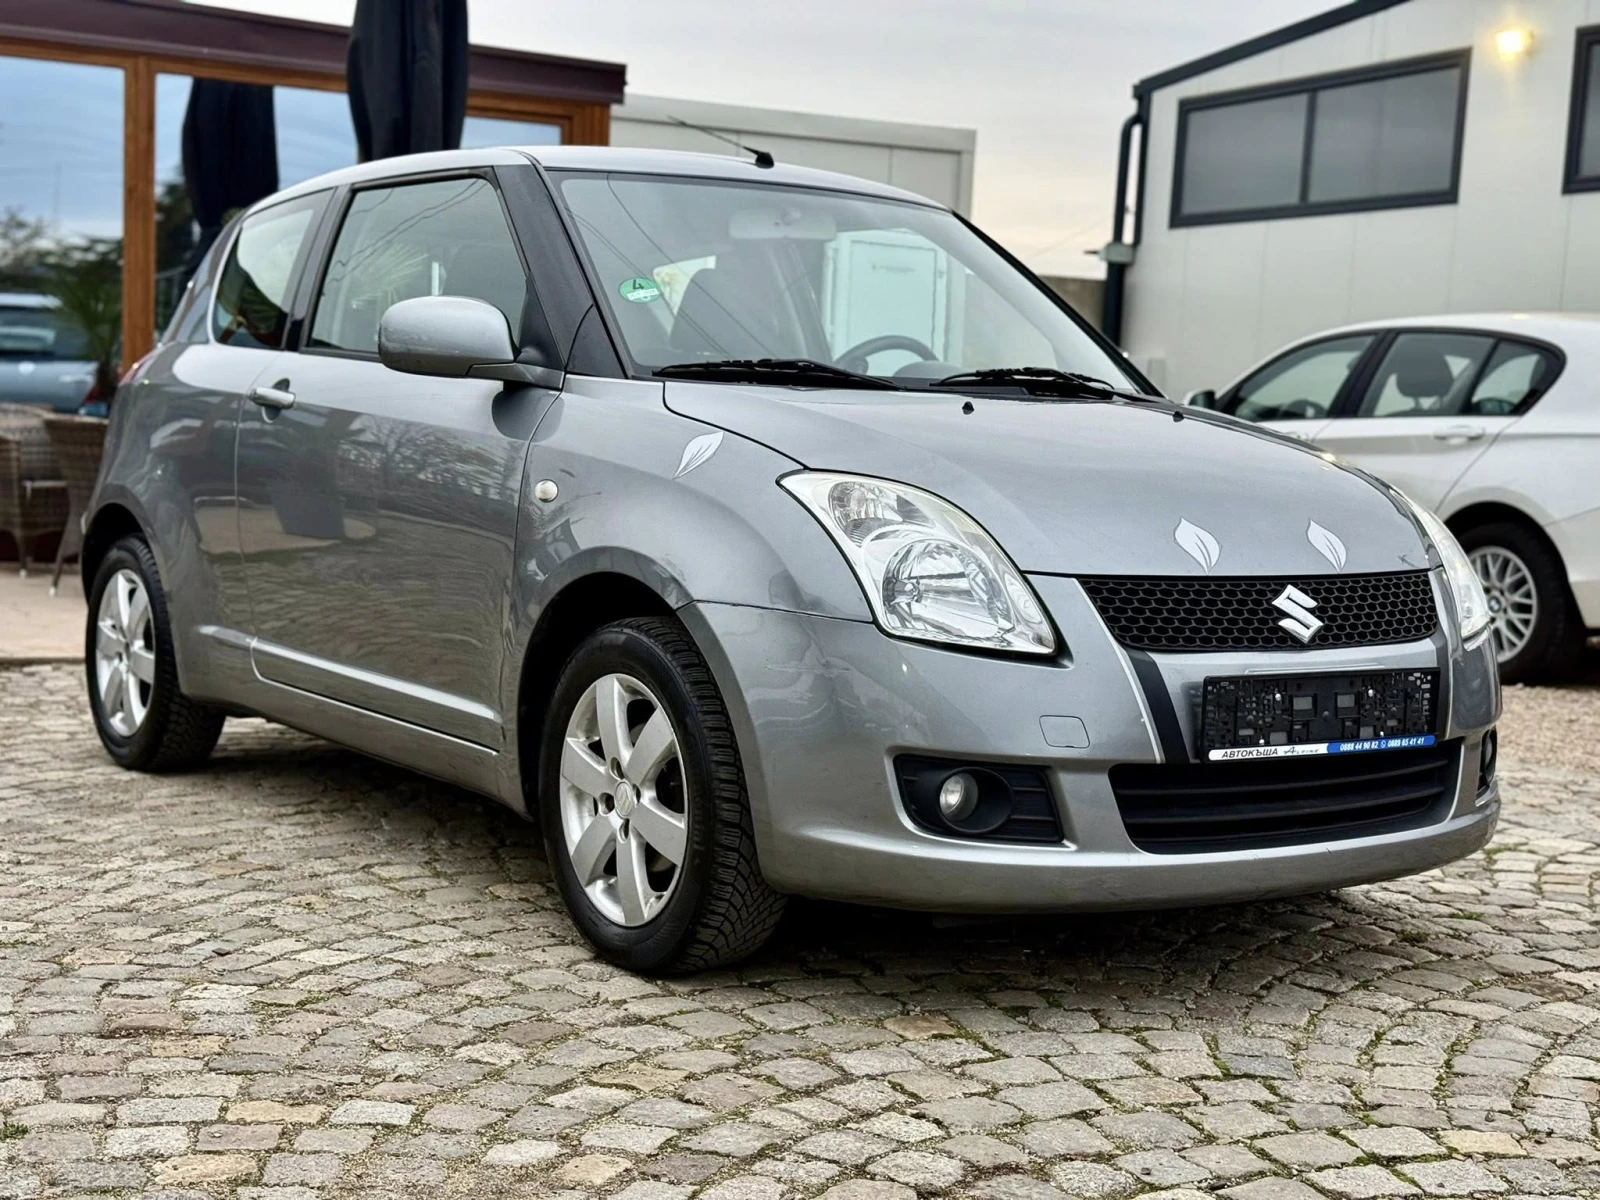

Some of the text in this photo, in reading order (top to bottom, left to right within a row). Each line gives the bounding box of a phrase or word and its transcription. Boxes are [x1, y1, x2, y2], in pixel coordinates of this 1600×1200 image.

[1355, 742, 1363, 750] 44
[1409, 737, 1417, 746] 41
[1417, 737, 1425, 745] 41
